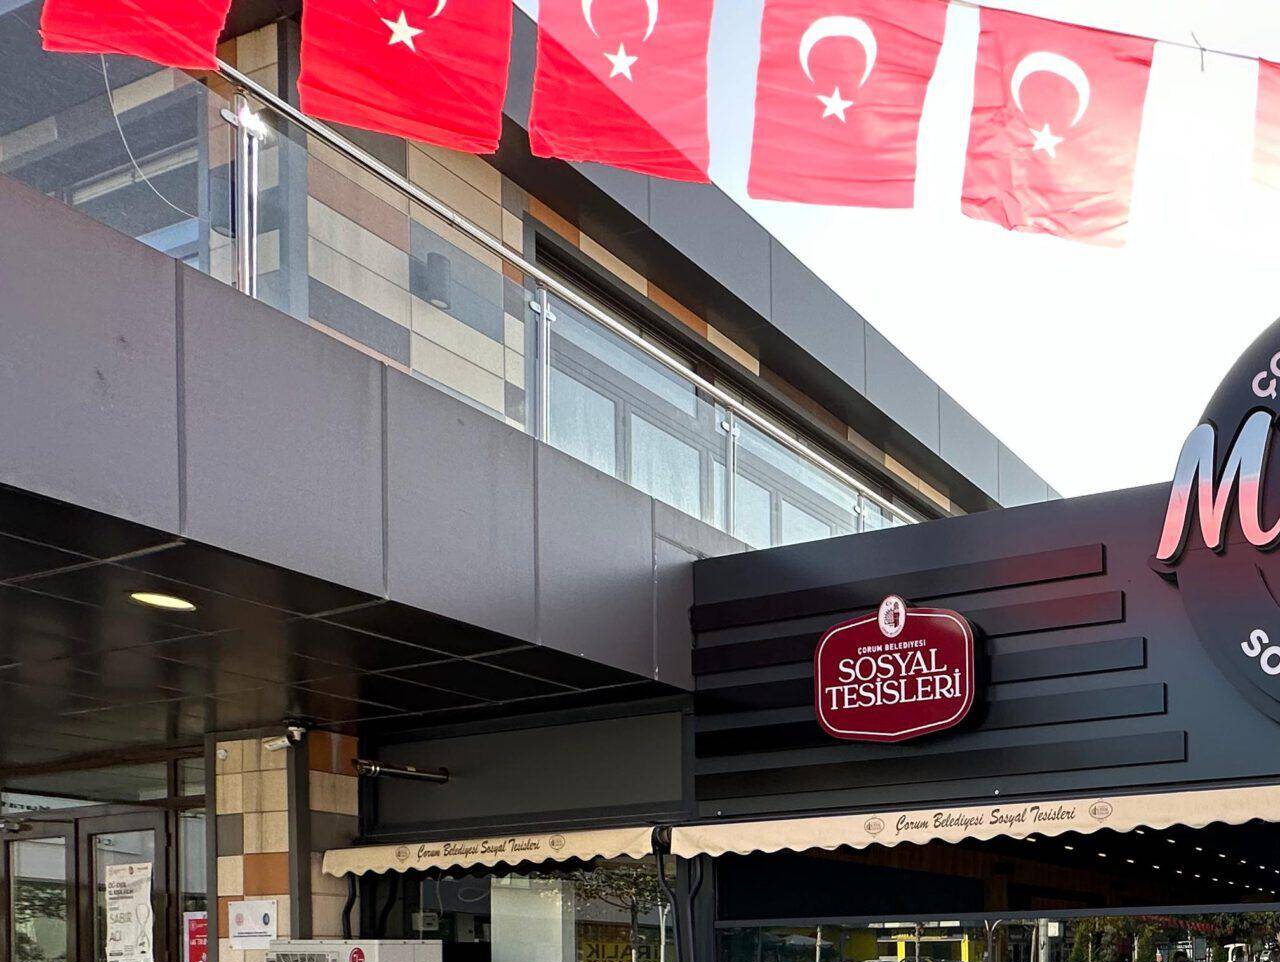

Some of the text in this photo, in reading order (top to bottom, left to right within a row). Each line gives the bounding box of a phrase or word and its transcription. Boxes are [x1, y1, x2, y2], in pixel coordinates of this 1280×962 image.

[838, 648, 947, 683] SOSYAL
[895, 805, 1076, 835] Çorum Belediyesi Sosyal Tesisleri
[480, 839, 507, 857] Sosyal
